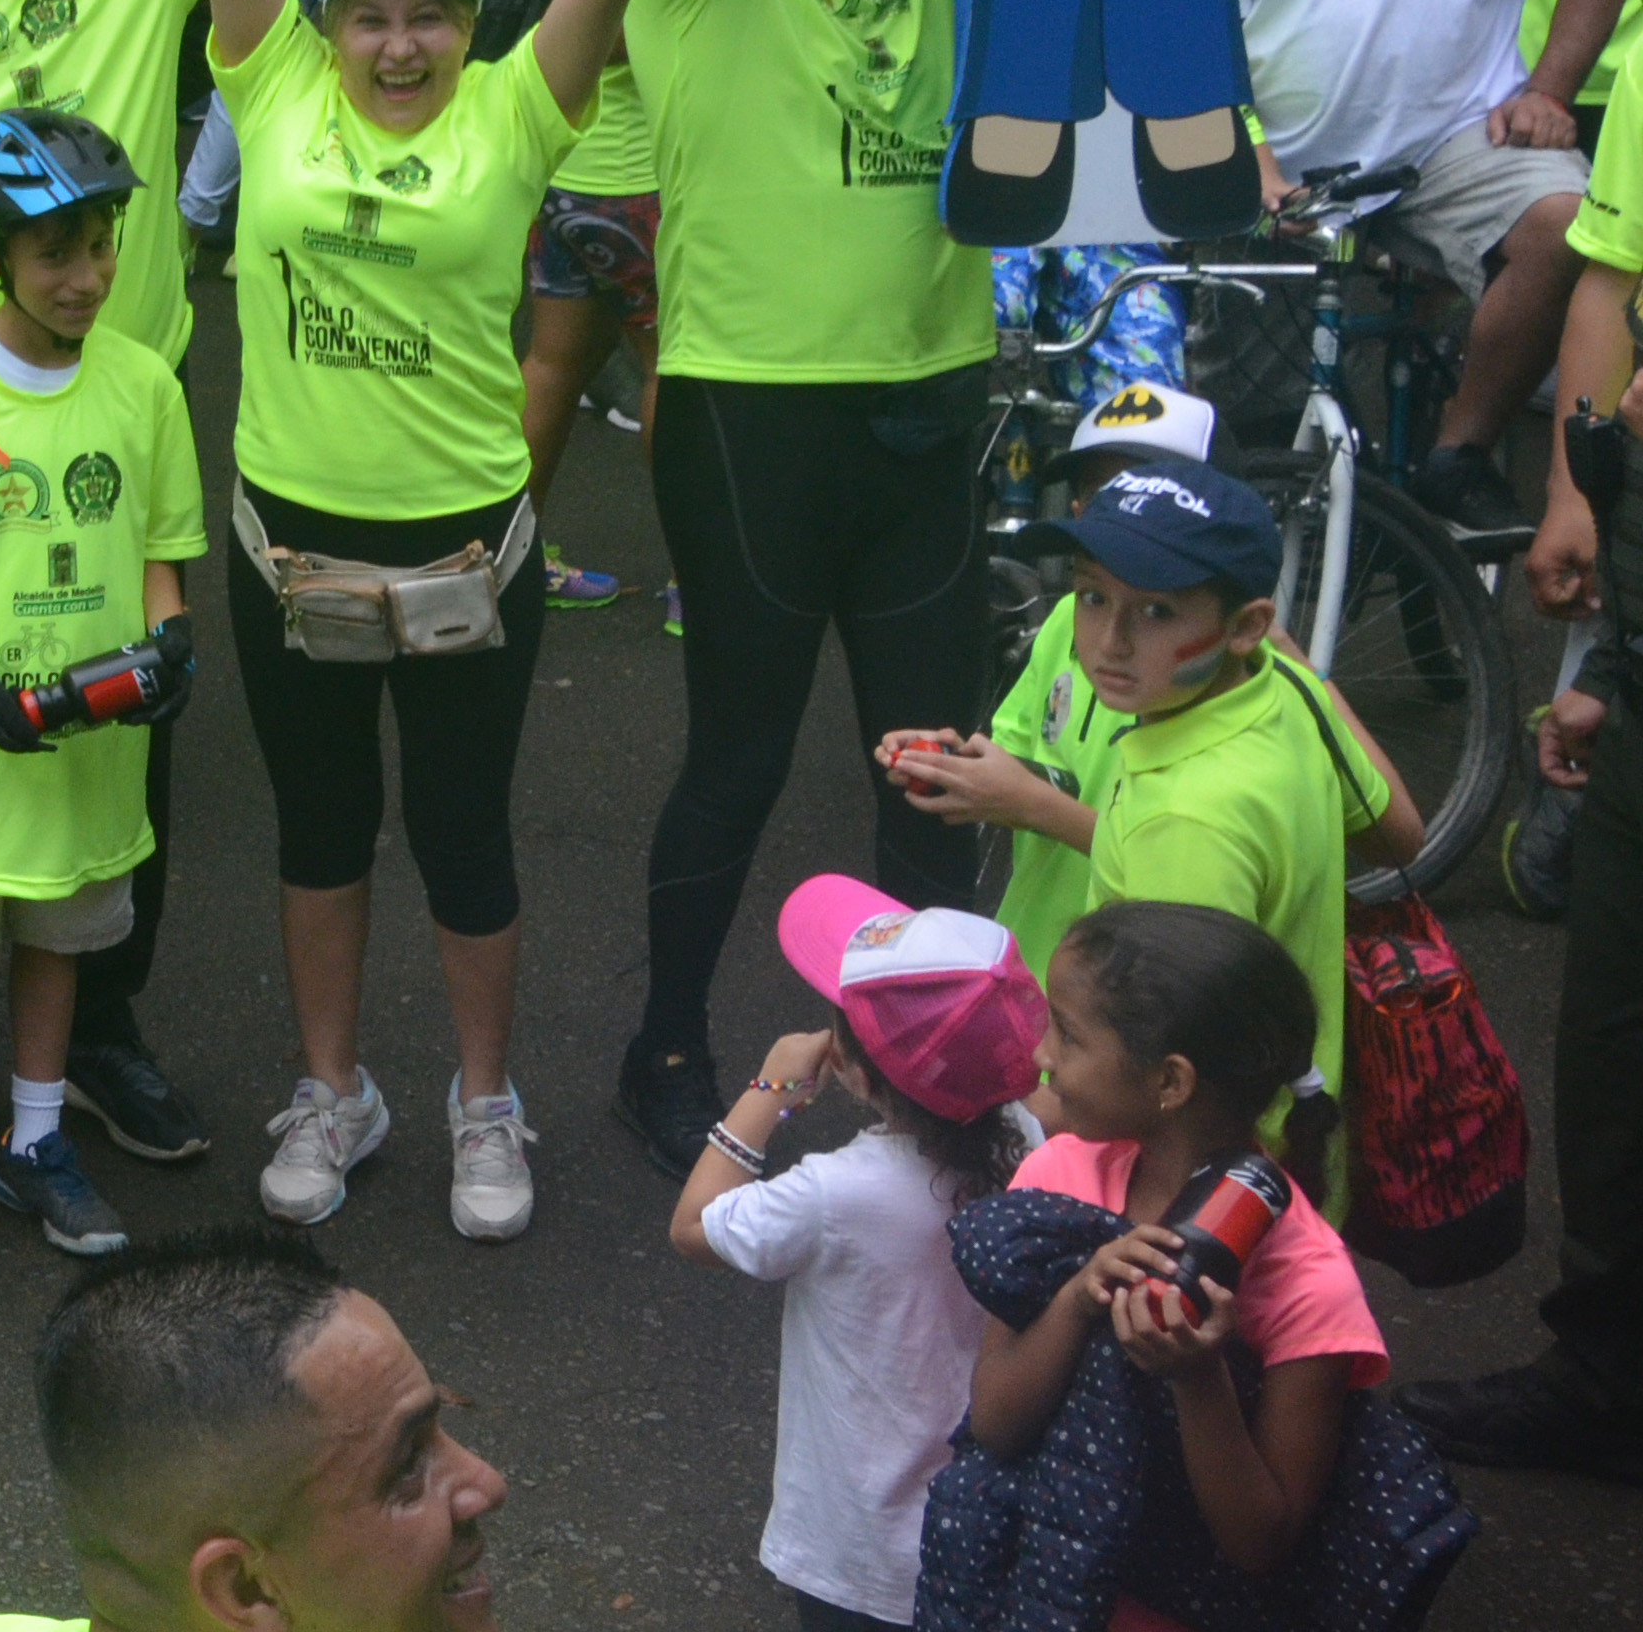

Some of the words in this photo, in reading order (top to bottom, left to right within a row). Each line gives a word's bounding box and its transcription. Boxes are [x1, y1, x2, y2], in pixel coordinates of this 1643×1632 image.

[1098, 470, 1212, 519] TERPOL
[12, 587, 50, 603] Alcaldía
[14, 600, 61, 617] Cuenta
[62, 600, 85, 614] con
[6, 648, 22, 662] ER
